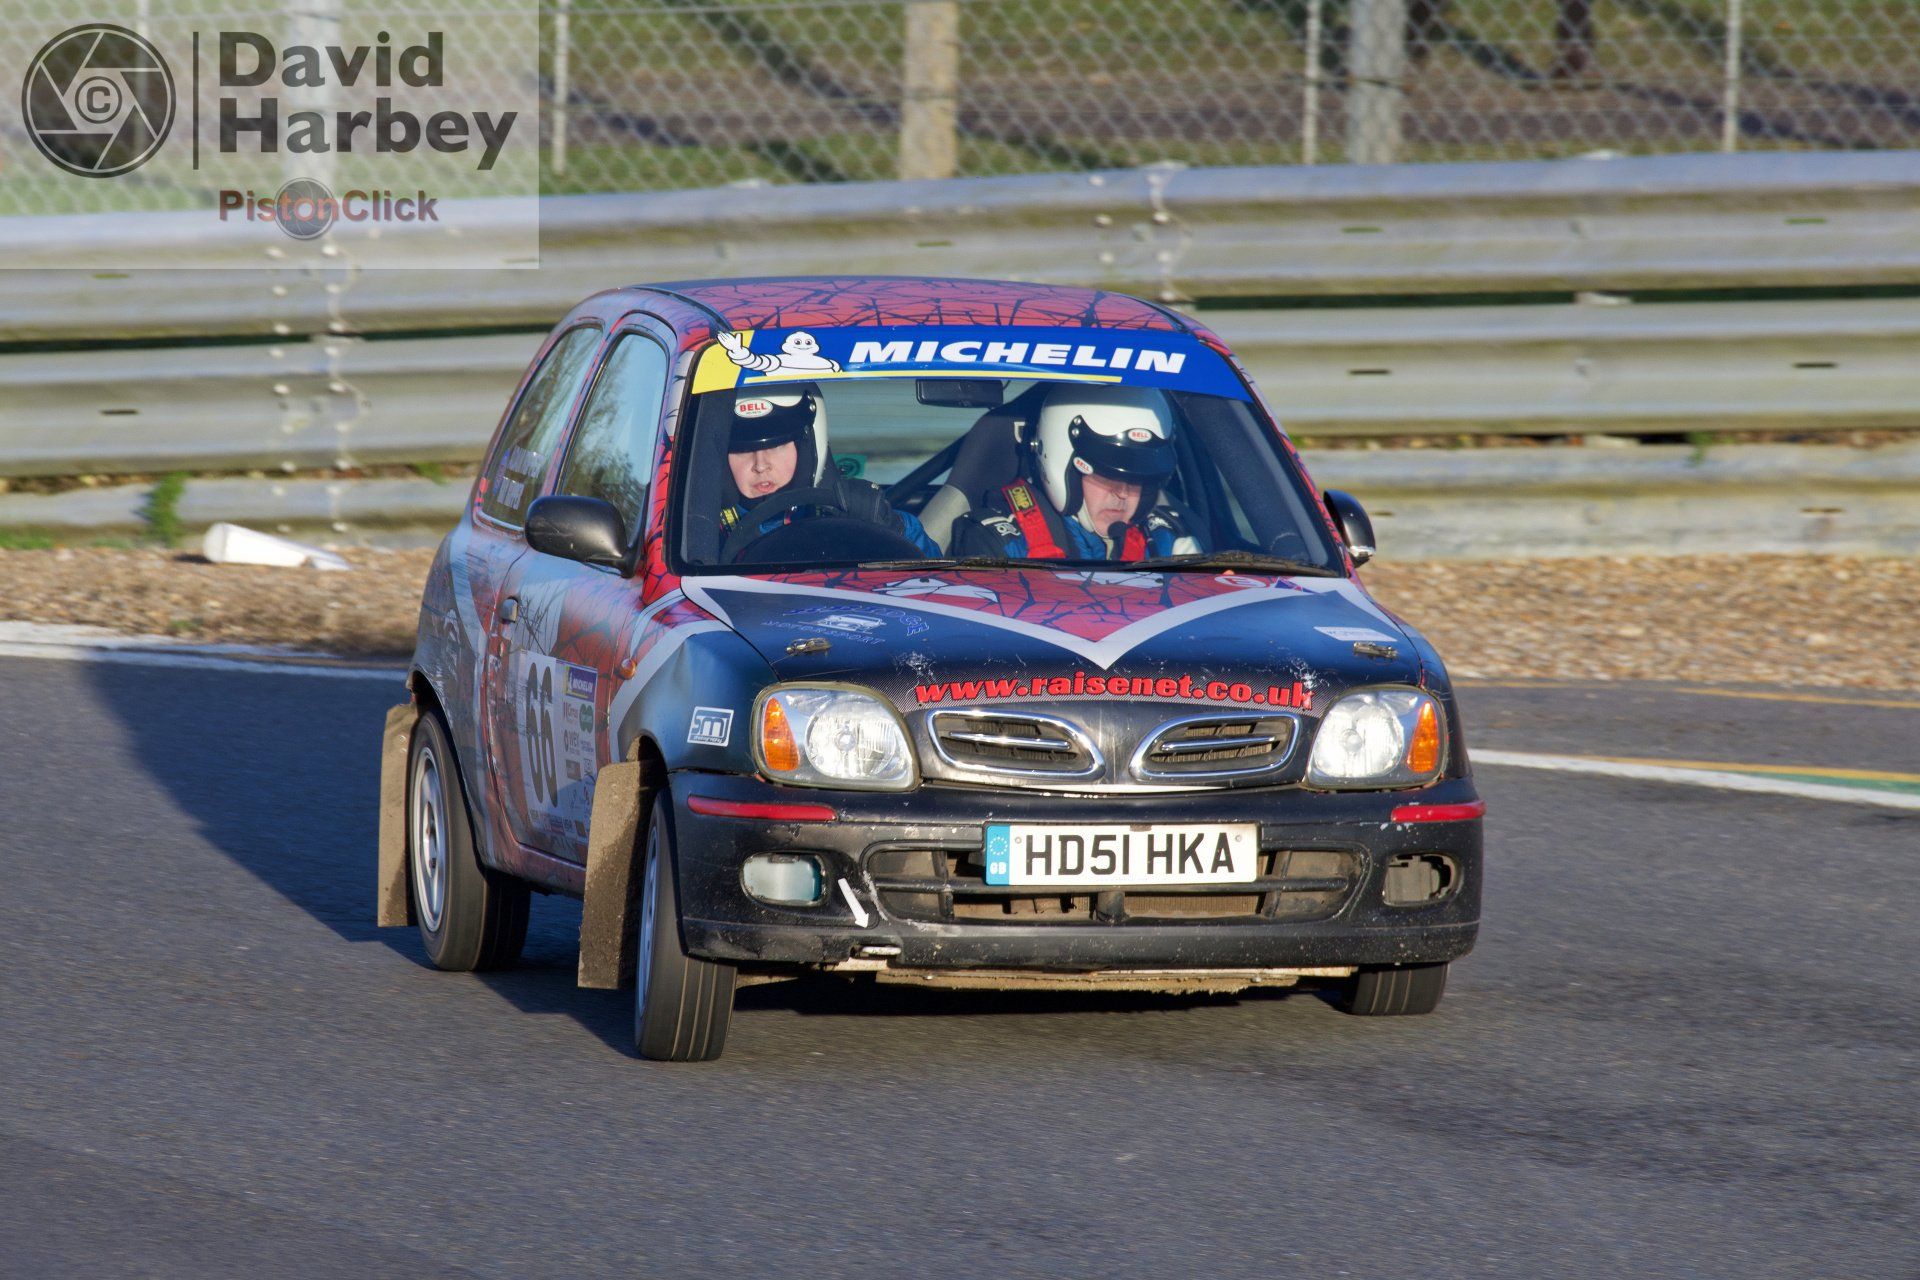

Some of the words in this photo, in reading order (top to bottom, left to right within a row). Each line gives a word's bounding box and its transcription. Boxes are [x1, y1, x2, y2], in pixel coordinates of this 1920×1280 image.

[849, 341, 1186, 374] MICHELIN
[739, 403, 767, 412] BELL
[1131, 431, 1149, 439] BELL
[1076, 459, 1090, 472] BELL
[915, 671, 1316, 710] www.raisenet.co.uk
[526, 662, 558, 808] 66
[1025, 834, 1130, 876] HD51
[1147, 831, 1235, 875] HKA
